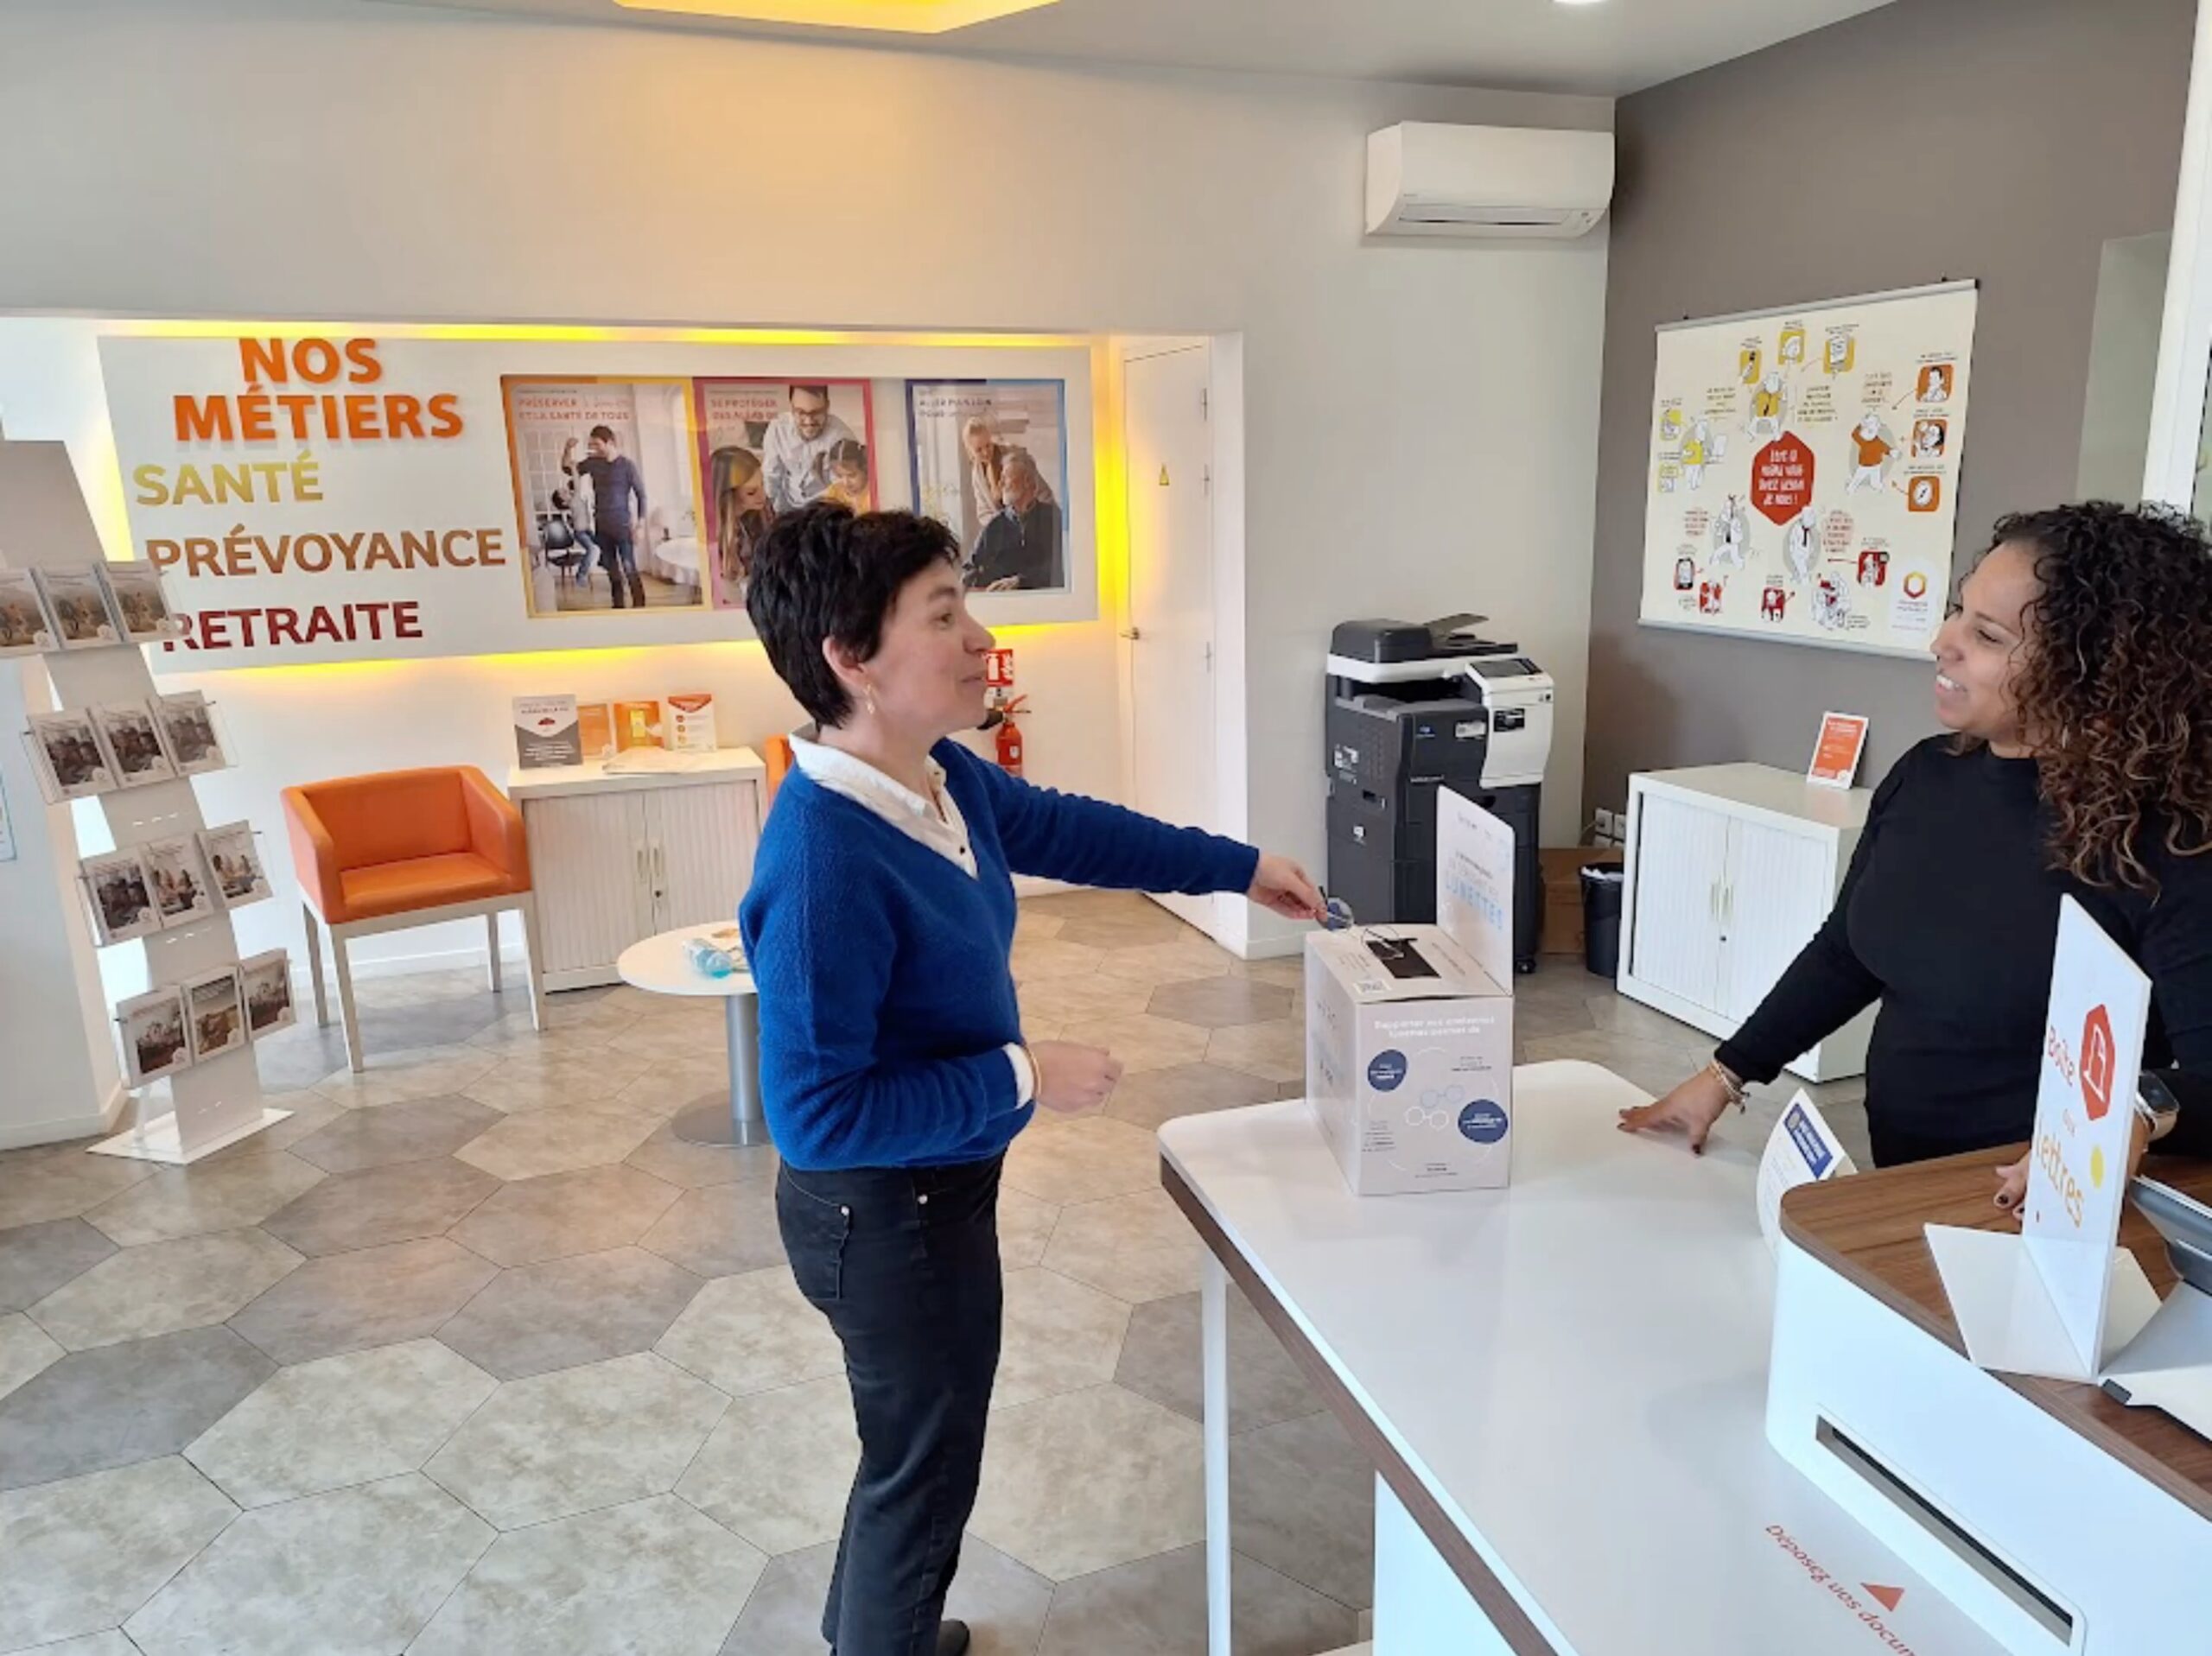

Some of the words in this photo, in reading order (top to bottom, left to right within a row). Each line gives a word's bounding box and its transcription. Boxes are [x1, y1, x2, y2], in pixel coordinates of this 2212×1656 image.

[238, 337, 383, 384] NOS
[173, 385, 464, 441] MÉTIERS
[132, 449, 324, 505] SANTÉ
[145, 523, 506, 577] PRÉVOYANCE
